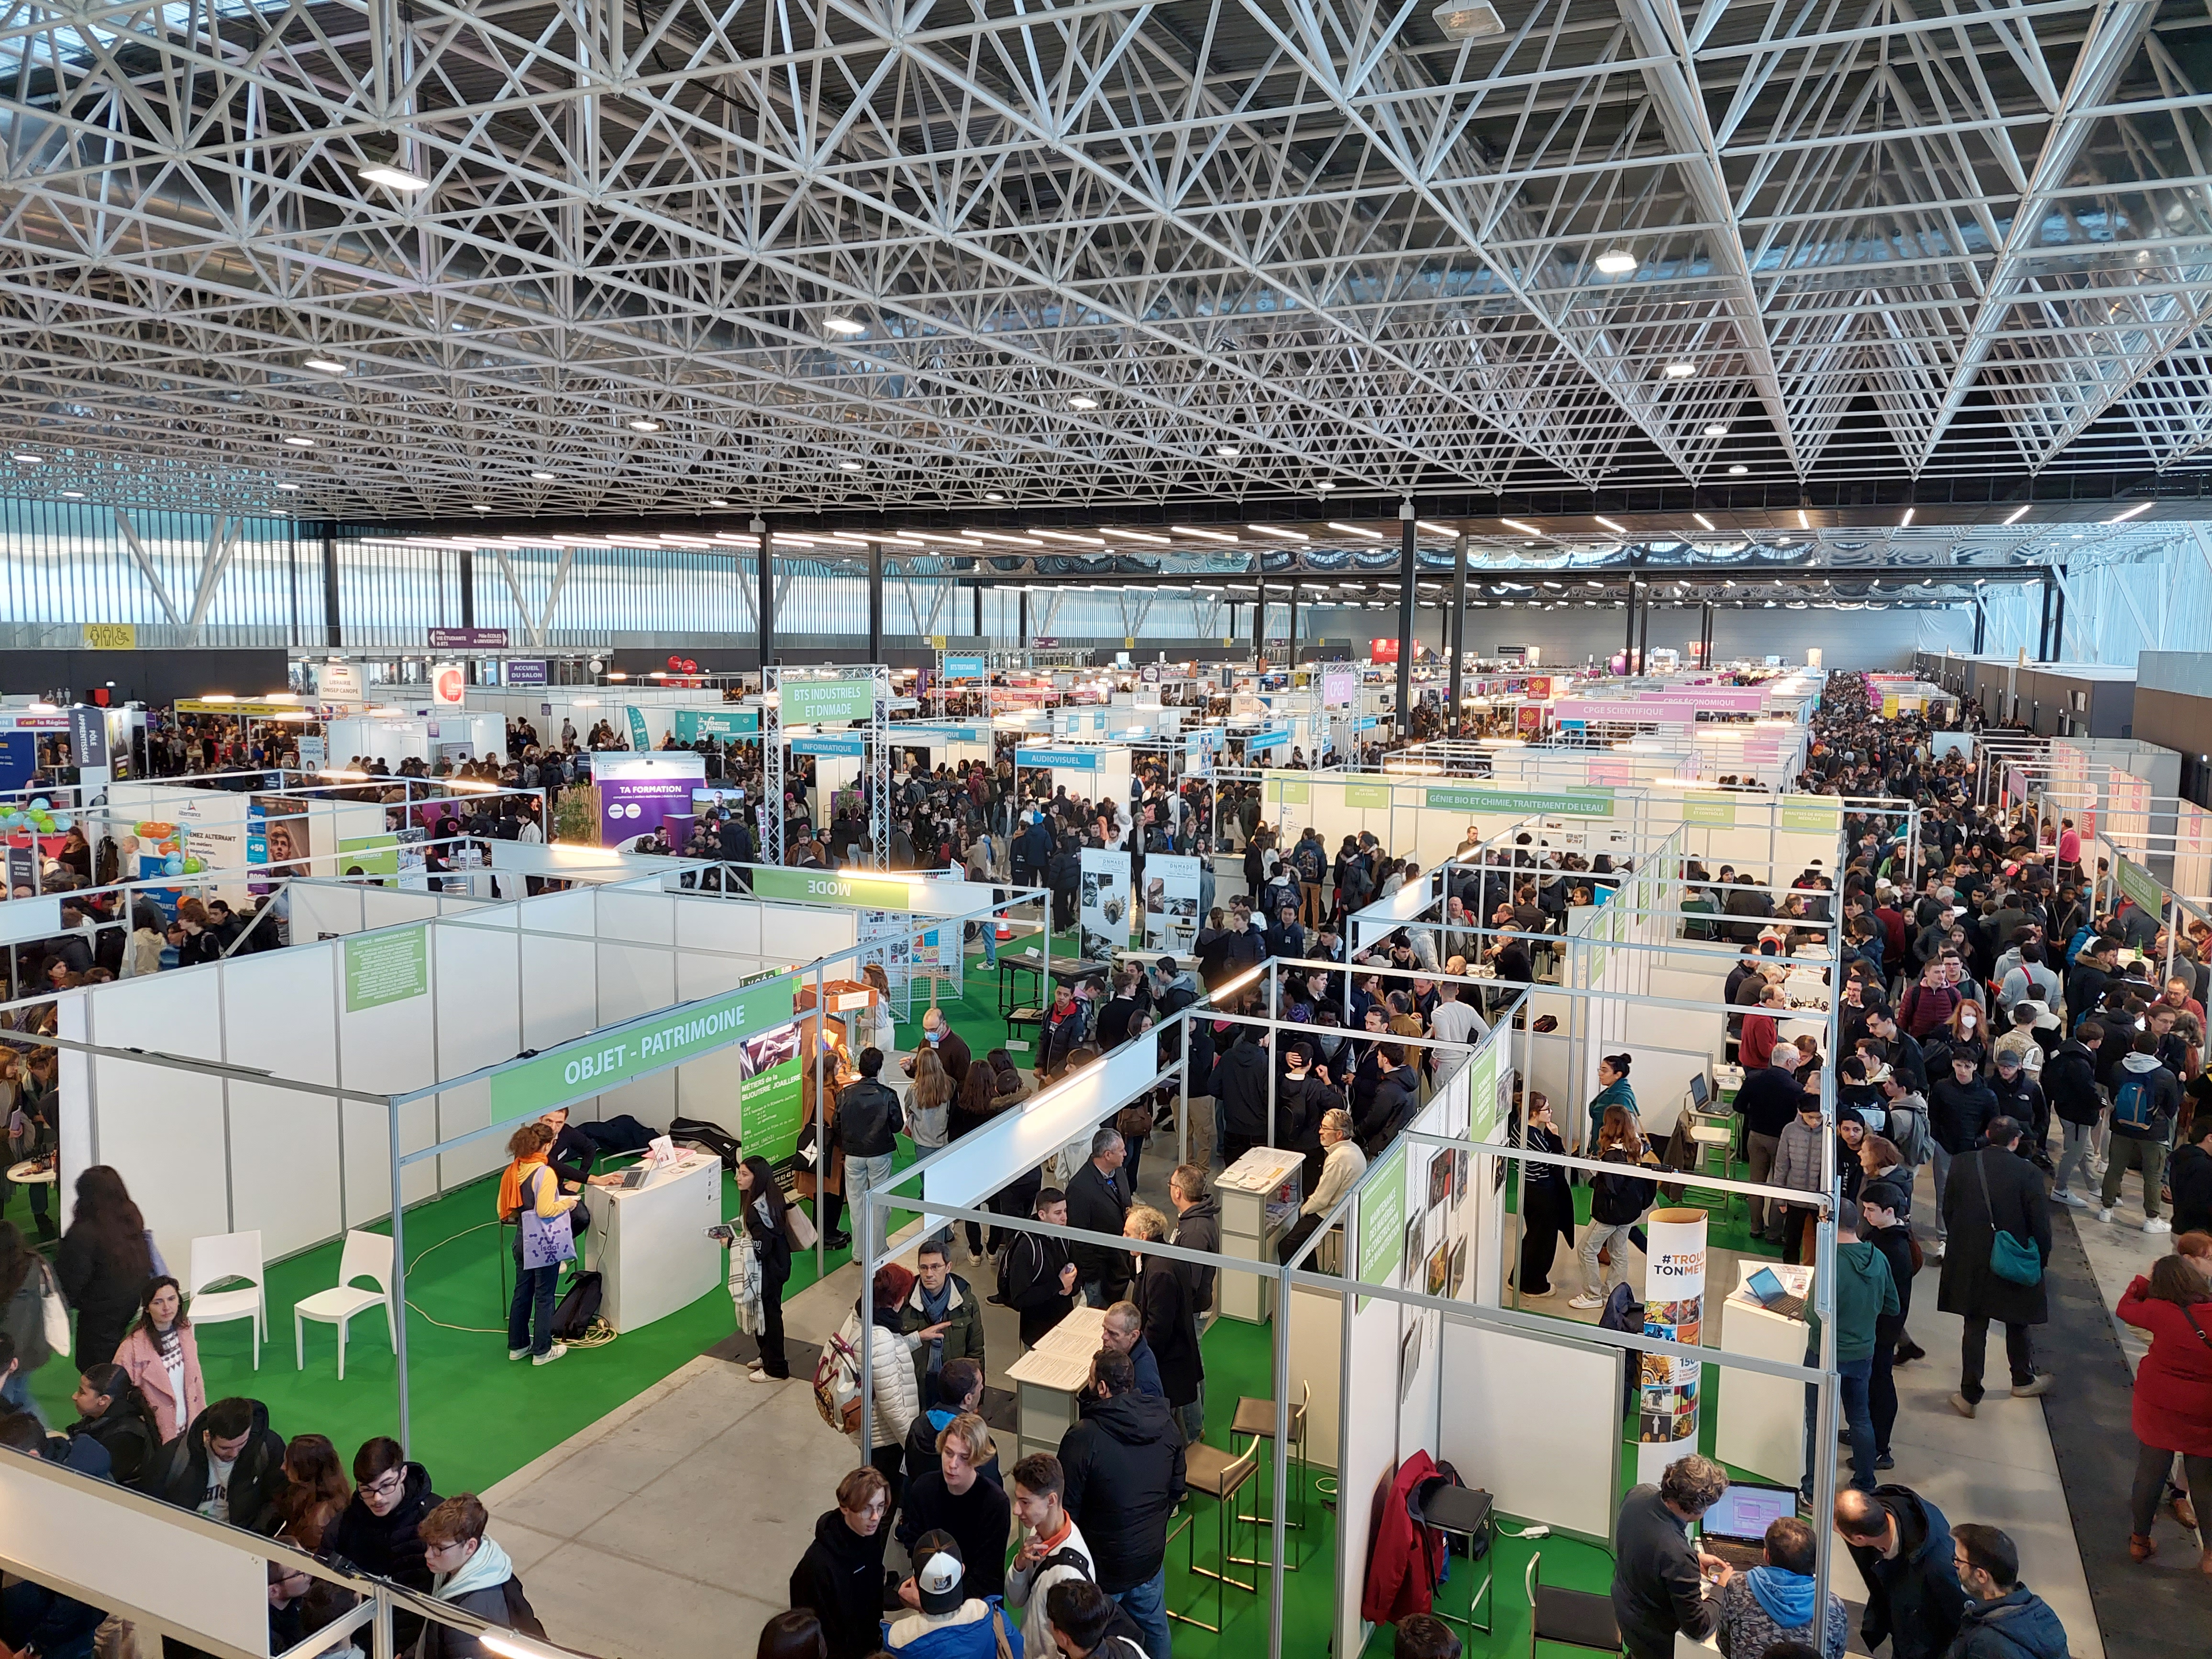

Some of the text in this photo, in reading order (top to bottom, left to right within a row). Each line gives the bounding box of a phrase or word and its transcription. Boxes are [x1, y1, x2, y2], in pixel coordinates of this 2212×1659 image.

[795, 686, 861, 701] BTS INDUSTRIELS
[1330, 681, 1344, 697] CPGE
[1685, 697, 1735, 706] ÉCONOMIQUE
[806, 703, 852, 717] ET DNMADE
[1607, 707, 1664, 716] SCIENTIFIQUE
[77, 713, 89, 763] APPRENTISSAGE
[803, 743, 852, 752] INFORMATIQUE
[1031, 755, 1080, 764] AUDIOVISUEL
[1429, 794, 1453, 803] GÉNIE
[1481, 798, 1512, 807] CHIMIE,
[1513, 800, 1566, 810] TRAITEMENT
[1581, 804, 1604, 812] L'EAU
[205, 833, 237, 841] ALTERNANT
[808, 880, 851, 896] MODE
[374, 933, 398, 942] INNOVATION
[564, 1005, 745, 1085] OBJET PATRIMOINE
[741, 1078, 765, 1092] MÉTIERS
[765, 1074, 772, 1084] de
[741, 1073, 801, 1101] BIJOUTERIE JOAILLERIE
[1370, 1187, 1396, 1226] MAINTENANCE
[1369, 1200, 1396, 1240] DES MATÉRIELS
[1365, 1210, 1399, 1261] DE CONSTRUCTION
[541, 1242, 560, 1252] isdaT
[1363, 1263, 1368, 1278] ET
[1369, 1255, 1374, 1271] DE
[1373, 1221, 1400, 1262] MANUTENTION
